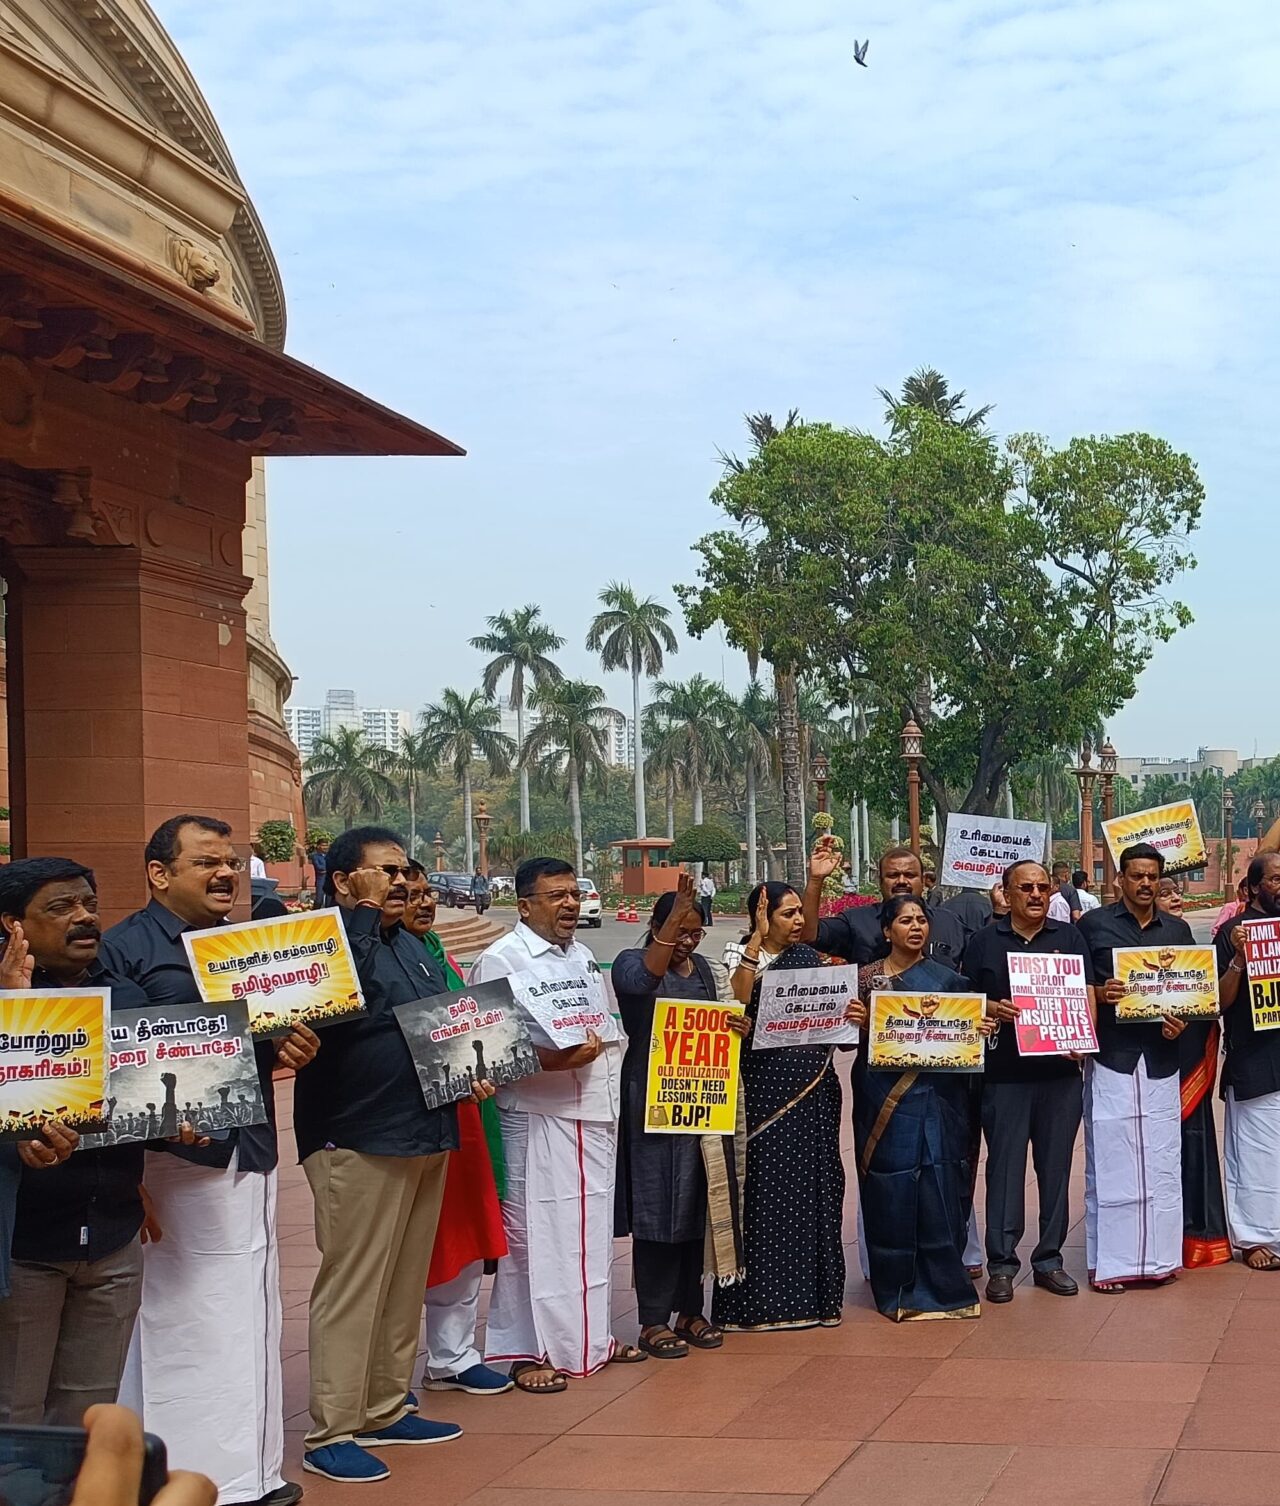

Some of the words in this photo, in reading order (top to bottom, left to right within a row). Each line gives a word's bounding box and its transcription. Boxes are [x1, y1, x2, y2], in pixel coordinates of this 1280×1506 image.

[960, 829, 1031, 847] உரிமையைக்
[970, 846, 1019, 860] கேட்டால்
[208, 951, 270, 973] உயர்தனிச்
[273, 938, 337, 961] செம்மொழி
[1252, 943, 1260, 959] A
[1010, 956, 1048, 974] FIRST
[1053, 958, 1080, 975] YOU
[231, 963, 328, 998] தமிழ்மொழி!
[1030, 975, 1066, 986] EXPLOIT
[1128, 970, 1154, 982] தீயை
[1157, 969, 1206, 982] தீண்டாதே!
[776, 981, 848, 998] உரிமையைக்
[1012, 985, 1034, 994] TAMIL
[1036, 986, 1061, 995] NADU'S
[1063, 987, 1087, 997] TAXES.
[1165, 981, 1214, 994] சீண்டாதே!
[449, 997, 478, 1018] தமிழ்
[785, 998, 837, 1014] கேட்டால்
[1034, 997, 1062, 1010] THEN
[1064, 998, 1085, 1011] YOU
[665, 1007, 677, 1029] A
[765, 1014, 849, 1032] அவமதிப்பதா?
[885, 1015, 913, 1028] தீயை
[917, 1015, 972, 1030] தீண்டாதே!
[1019, 1009, 1062, 1025] INSULT
[1067, 1011, 1089, 1025] ITS
[1255, 1014, 1260, 1025] A
[137, 1016, 226, 1042] தீண்டாதே!
[432, 1019, 471, 1041] எங்கள்
[475, 1011, 503, 1028] உயிர்!
[1039, 1025, 1092, 1041] PEOPLE
[877, 1030, 921, 1043] தமிழரை
[925, 1030, 979, 1044] சீண்டாதே!
[1056, 1039, 1096, 1050] ENOUGH!
[155, 1038, 241, 1060] சீண்டாதே!
[664, 1031, 730, 1067] YEAR
[658, 1066, 674, 1077] OLD
[677, 1066, 730, 1079] CIVILIZATION
[662, 1079, 699, 1091] DOESN'T
[702, 1080, 725, 1092] NEED
[657, 1091, 697, 1103] LESSONS
[700, 1092, 728, 1105] FROM
[672, 1105, 711, 1127] BJP!
